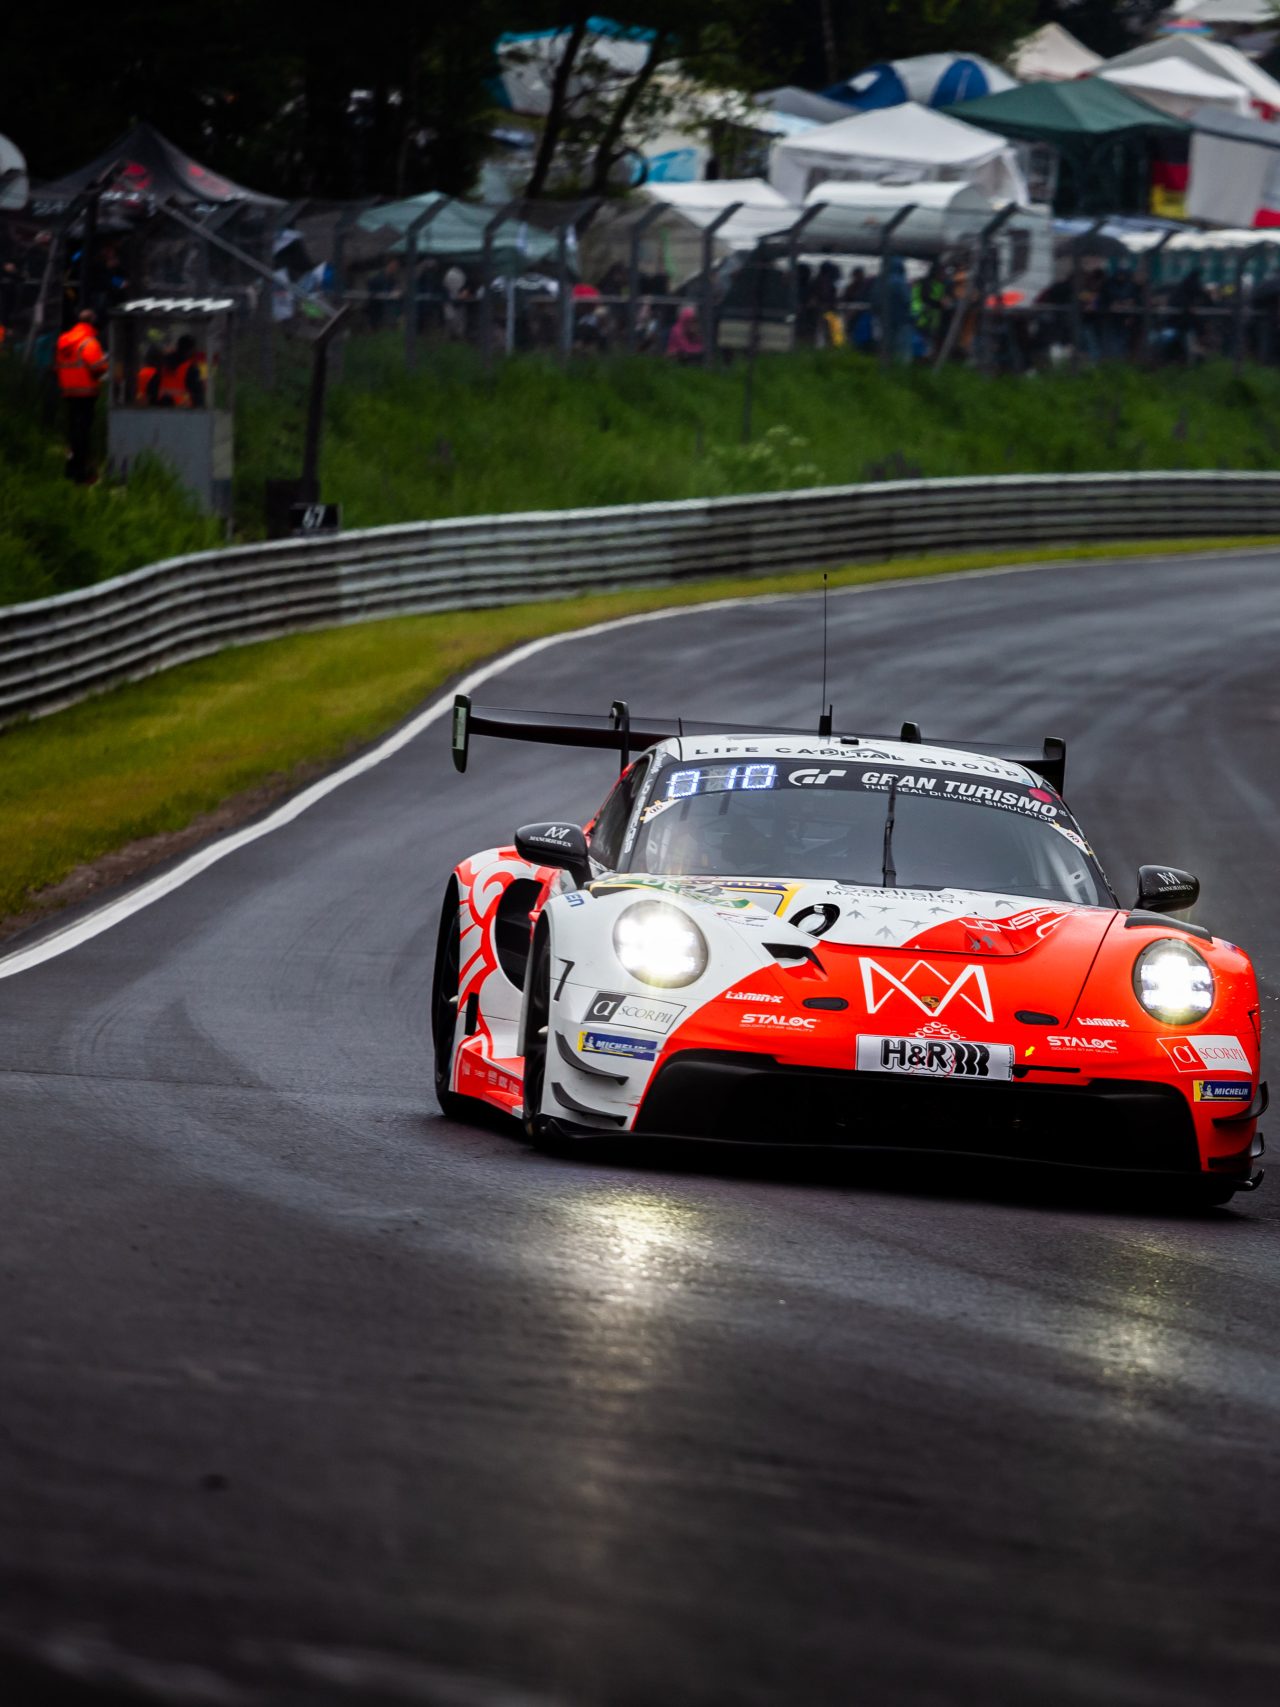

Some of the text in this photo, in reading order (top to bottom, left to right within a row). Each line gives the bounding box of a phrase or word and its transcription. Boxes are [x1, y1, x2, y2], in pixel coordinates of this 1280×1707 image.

[303, 505, 326, 529] 67
[695, 747, 1019, 778] LIFE CAPITAL GROUP
[861, 771, 1058, 818] GRAN TURISMO
[863, 784, 890, 792] THE
[896, 786, 927, 796] REAL
[985, 799, 1055, 823] SIMULATOR
[826, 890, 965, 905] MANAGEMENT
[834, 884, 955, 900] Carlisle
[618, 1006, 674, 1024] SCORPII
[741, 1013, 817, 1029] STALOC
[1046, 1035, 1118, 1050] STALOC
[881, 1038, 952, 1073] H&R
[1214, 1087, 1249, 1096] MICHELIN
